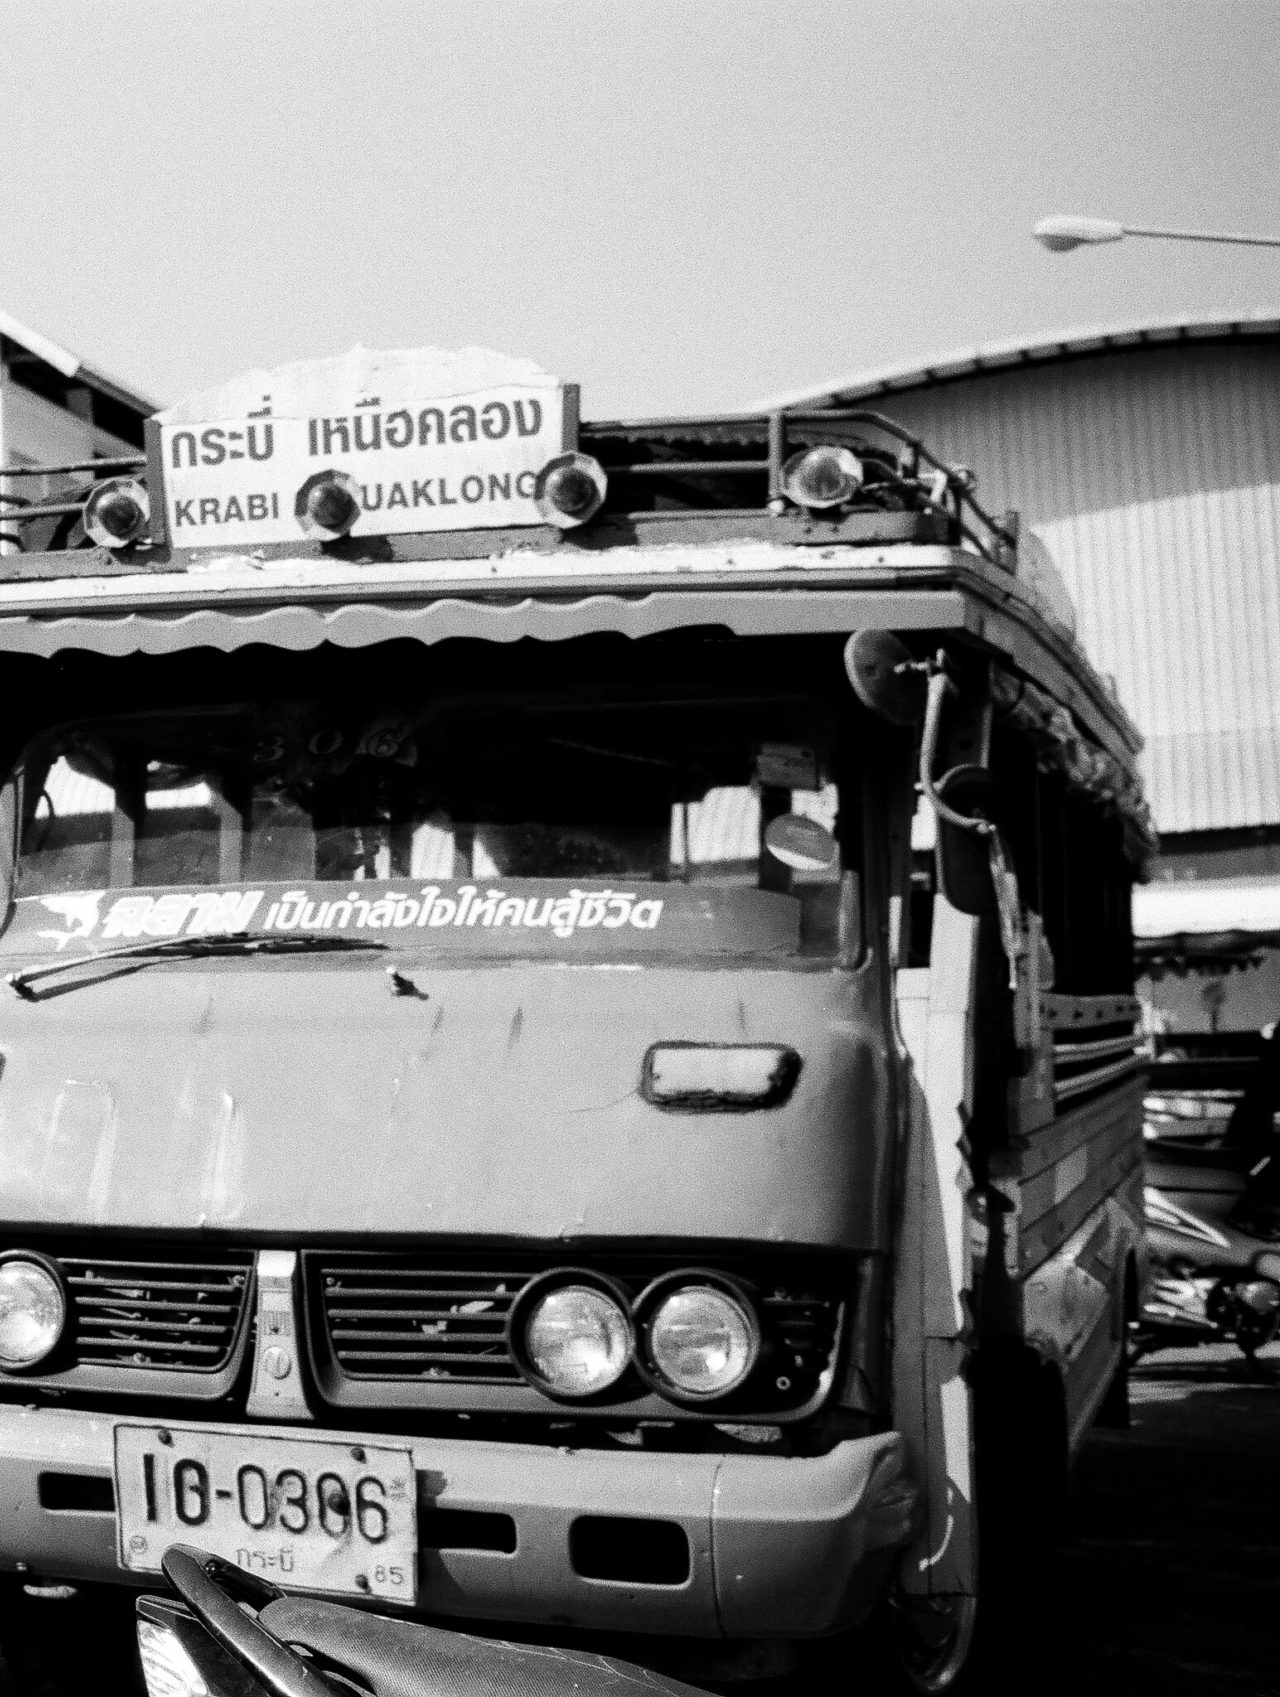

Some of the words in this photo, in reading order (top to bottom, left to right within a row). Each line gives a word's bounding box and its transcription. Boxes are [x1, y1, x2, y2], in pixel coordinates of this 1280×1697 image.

[172, 394, 274, 468] กระบี่
[308, 397, 543, 457] เหนือคลอง
[174, 492, 279, 528] KRABI
[360, 469, 538, 512] UAKLONG
